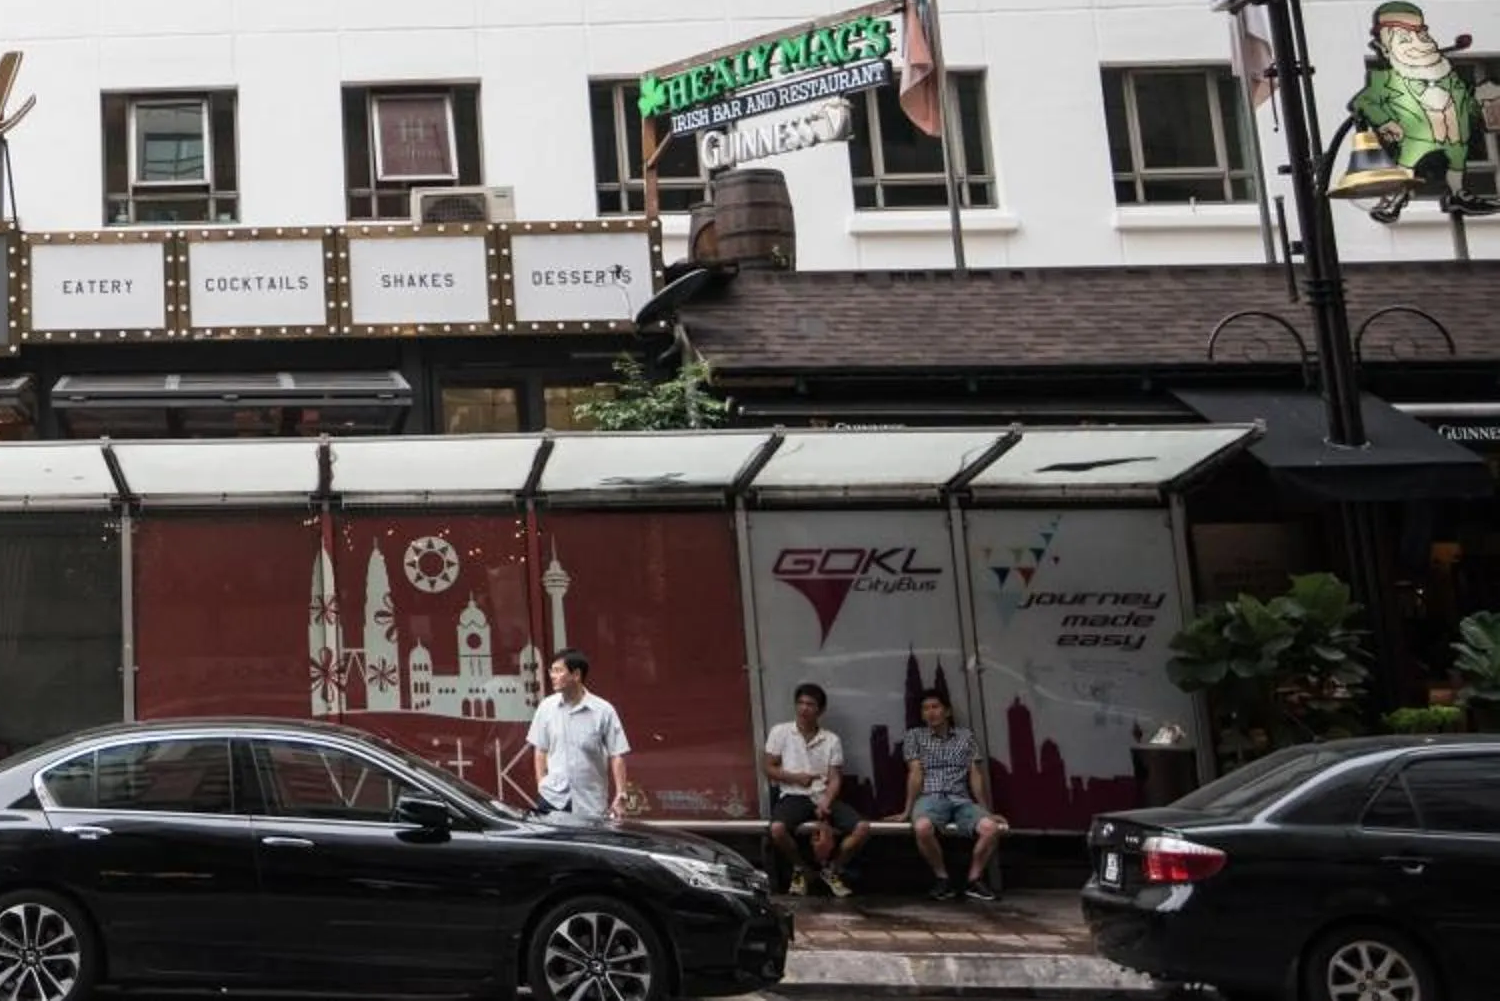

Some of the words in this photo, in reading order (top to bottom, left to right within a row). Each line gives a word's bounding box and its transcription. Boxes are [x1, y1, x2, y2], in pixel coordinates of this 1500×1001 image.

[670, 109, 709, 133] IRISH
[712, 103, 741, 124] BAR
[745, 91, 777, 115] AND
[780, 64, 884, 105] RESTAURANT
[701, 114, 821, 168] GUINNESS
[62, 279, 134, 294] EATERY
[204, 275, 309, 293] COCKTAILS
[381, 272, 455, 289] SHAKES
[1437, 423, 1500, 440] GUINNE
[771, 547, 943, 576] GOKL
[854, 576, 938, 595] CityBus
[1016, 591, 1167, 610] journey
[1060, 611, 1156, 628] made
[1056, 633, 1147, 650] easy
